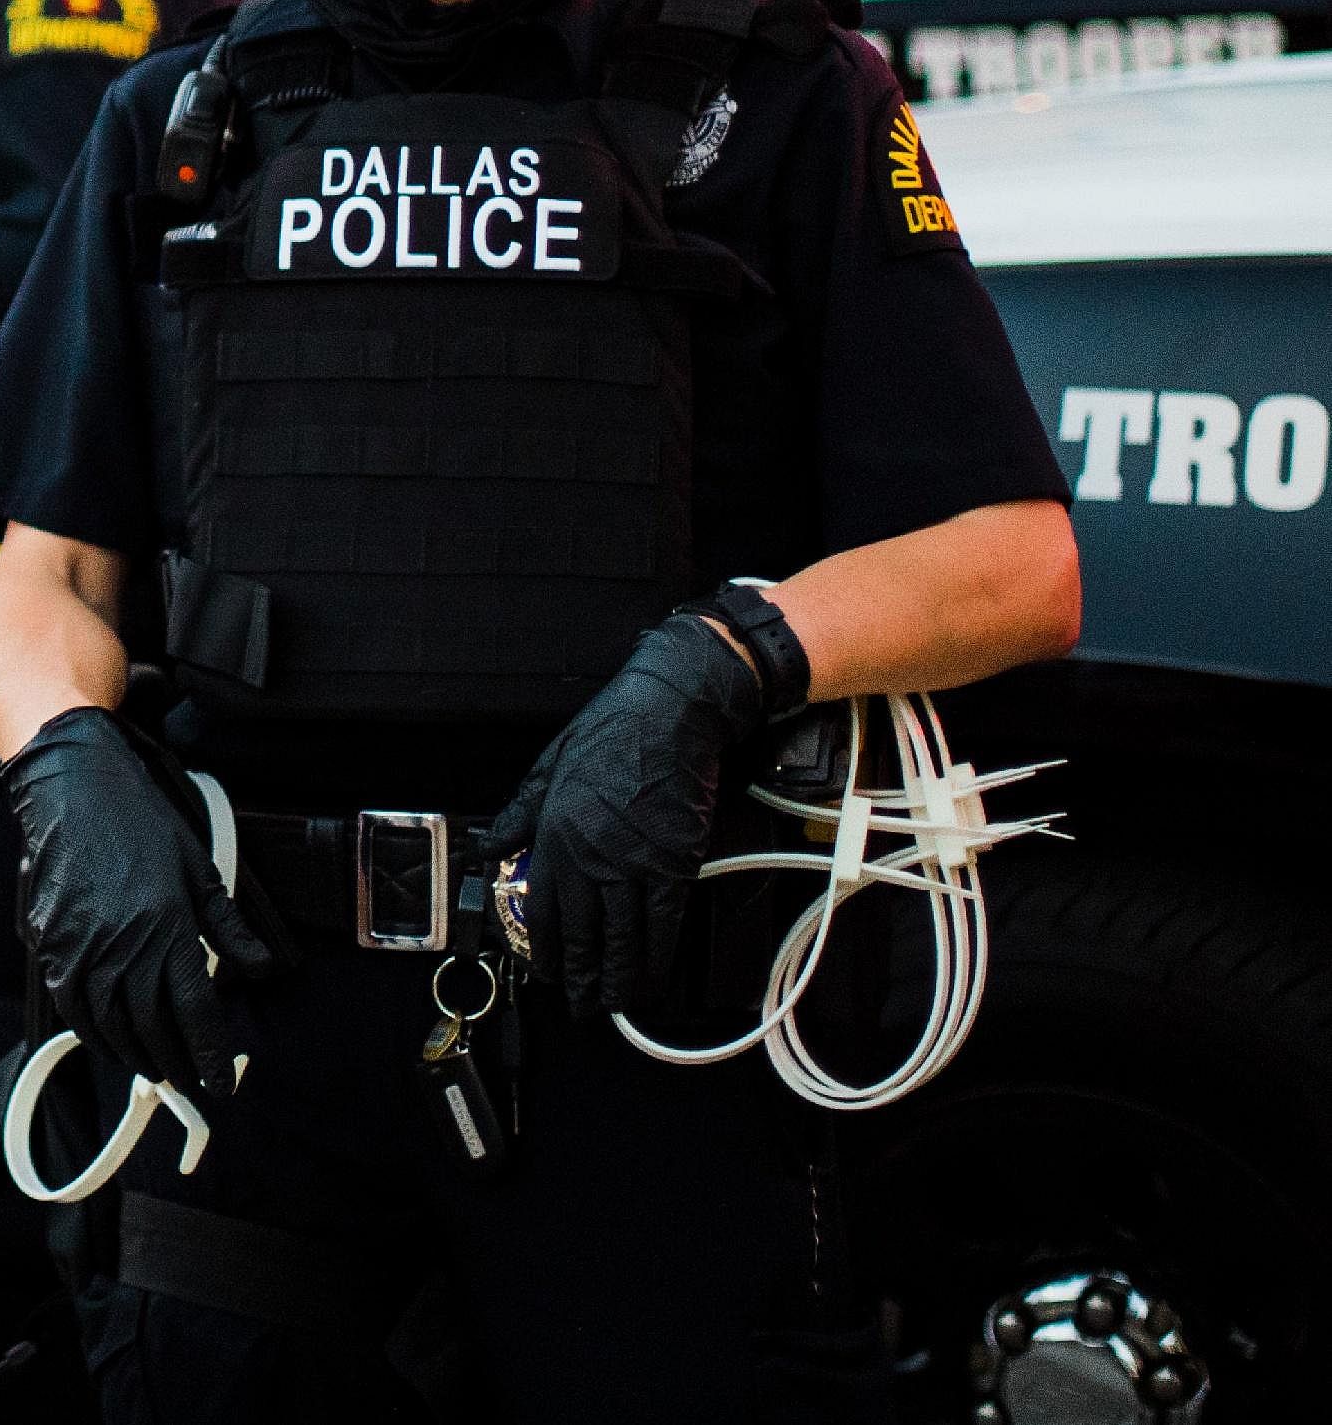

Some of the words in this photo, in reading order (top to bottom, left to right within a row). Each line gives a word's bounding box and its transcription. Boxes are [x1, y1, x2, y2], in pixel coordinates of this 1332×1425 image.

[908, 12, 1286, 99] TROOPER
[321, 146, 541, 196] DALLAS
[278, 195, 583, 272] POLICE
[1058, 387, 1329, 513] TRO
